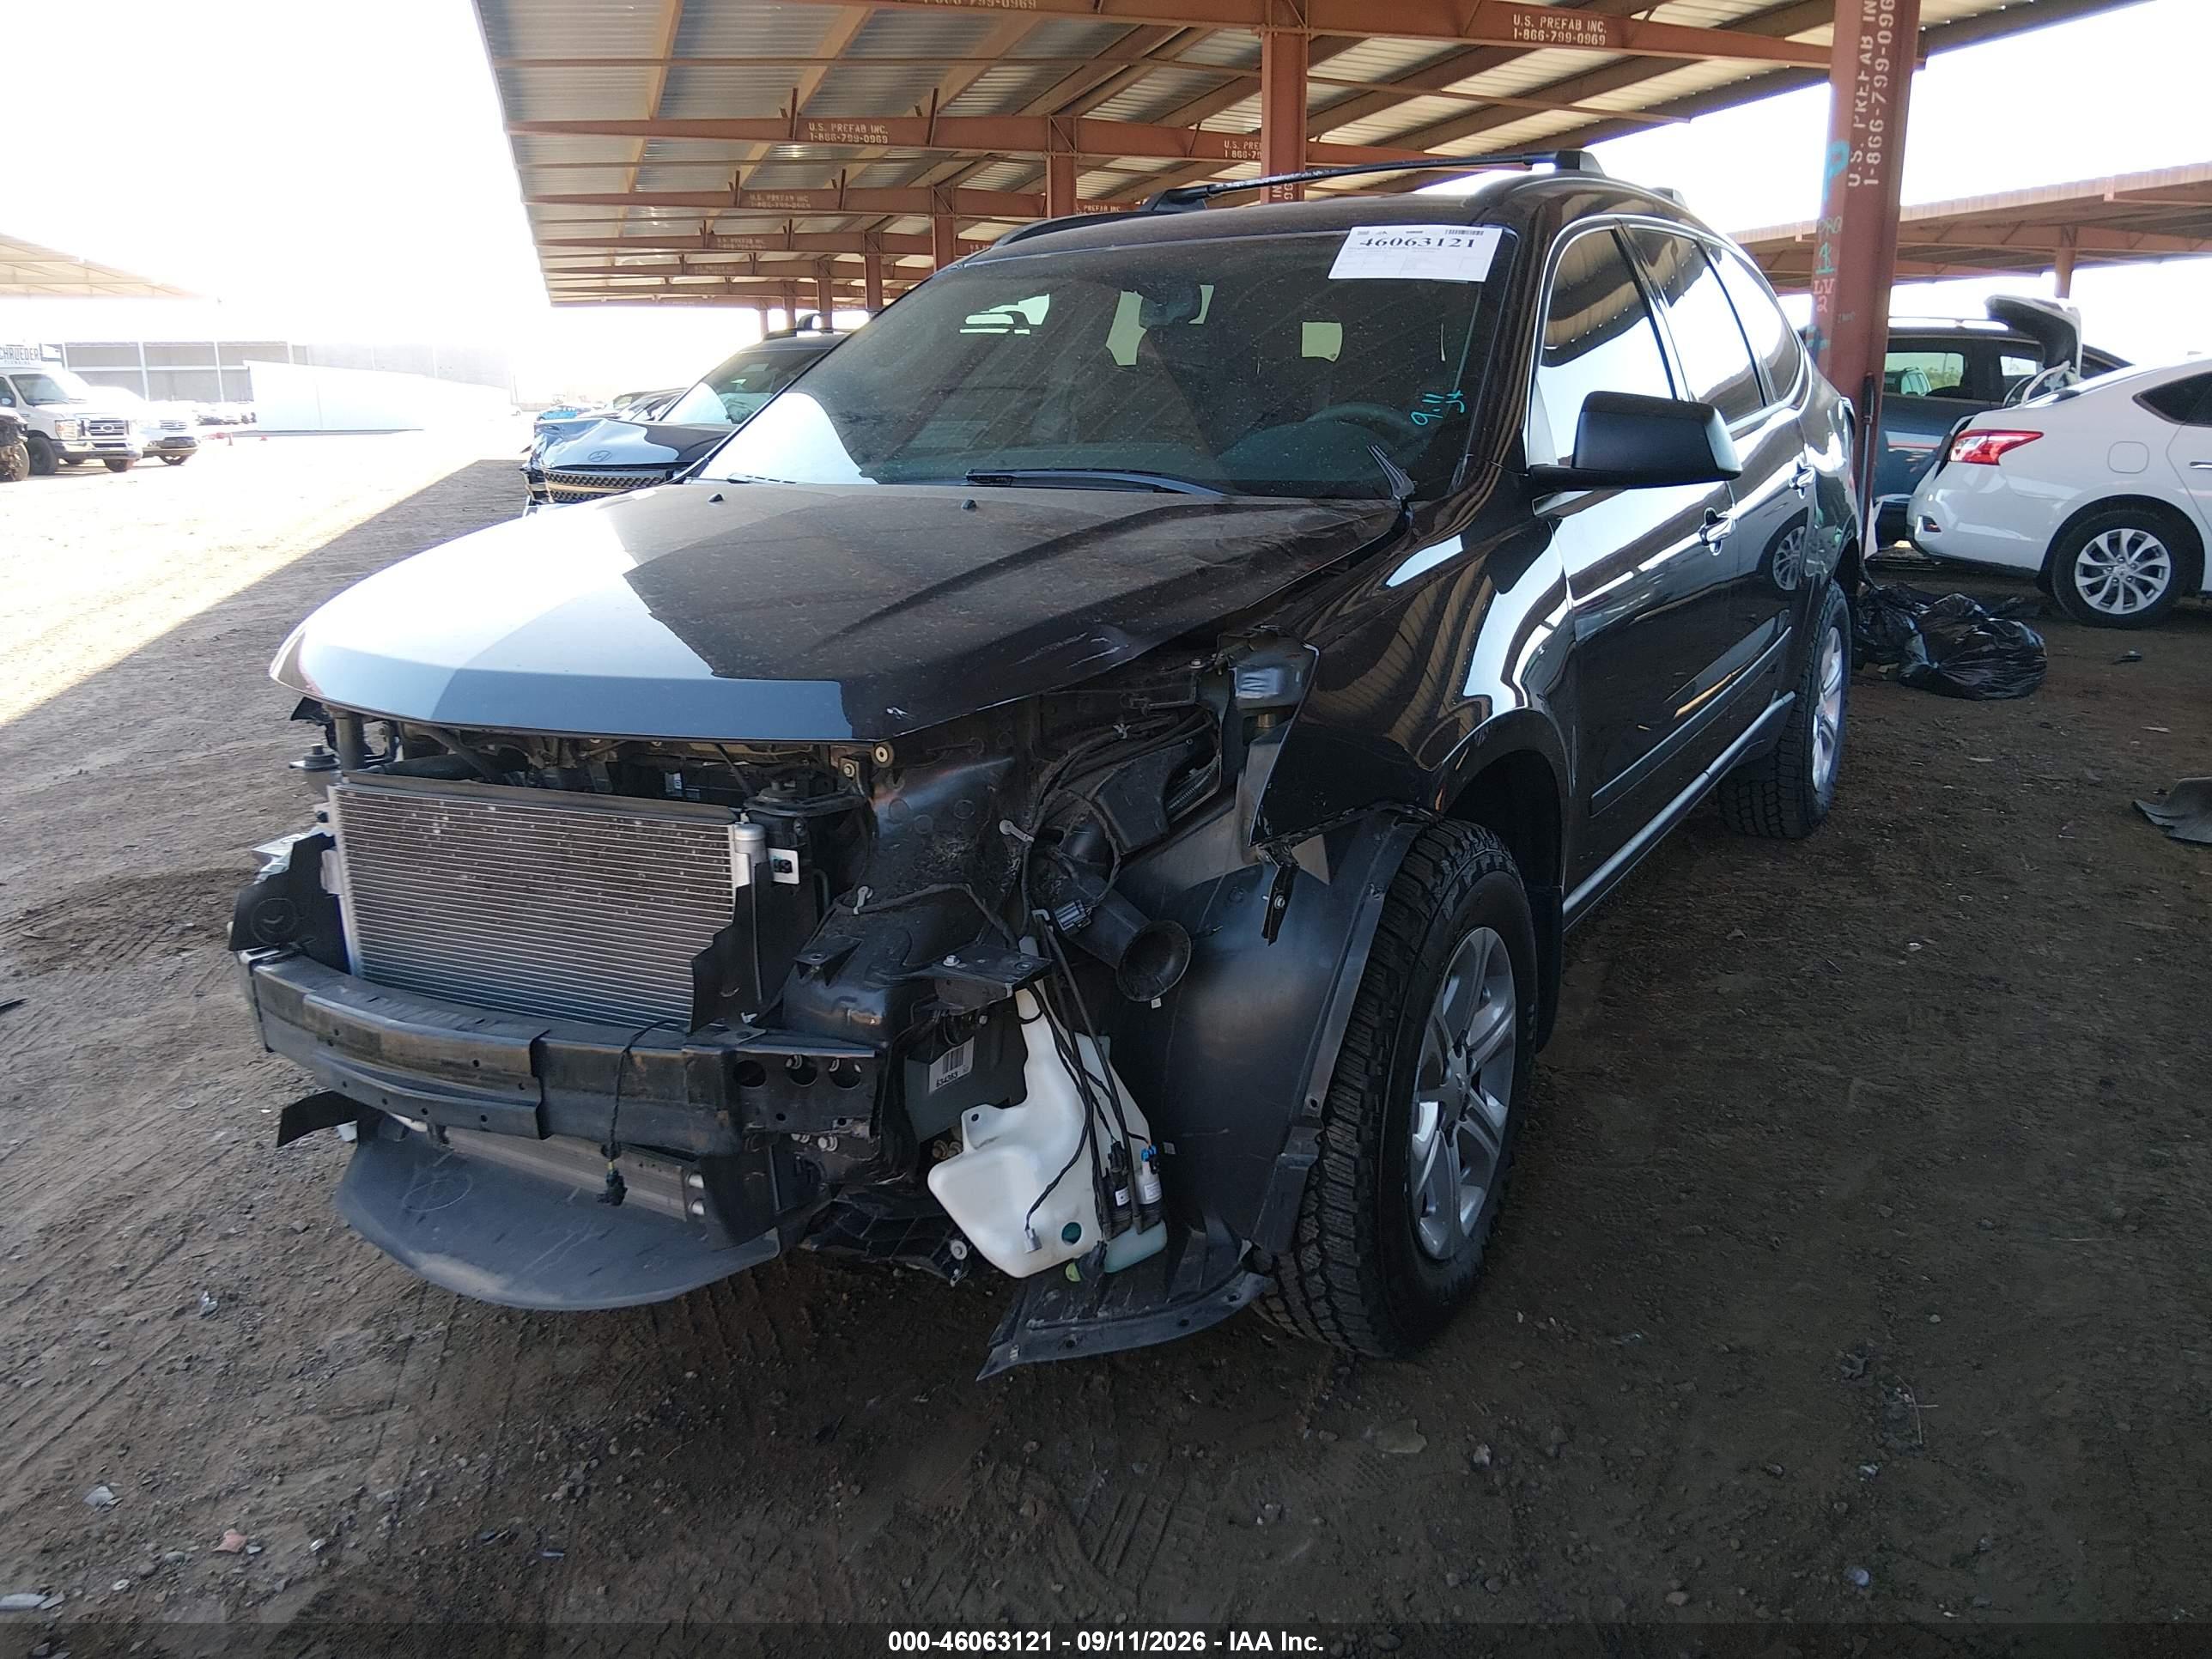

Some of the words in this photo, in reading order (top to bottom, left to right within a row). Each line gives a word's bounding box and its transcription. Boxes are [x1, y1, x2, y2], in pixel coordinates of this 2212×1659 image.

[1513, 14, 1534, 27] U.S.
[1540, 16, 1582, 31] PREFAB
[1587, 20, 1607, 33] INC.
[1513, 27, 1606, 46] 1-866-799-0969
[1853, 35, 1874, 128] PREFAB
[808, 122, 827, 131] U.S.
[830, 123, 866, 133] PREFAB
[1224, 140, 1240, 149] U.S.
[1847, 143, 1864, 187] U.S.
[1359, 237, 1475, 248] 46063121
